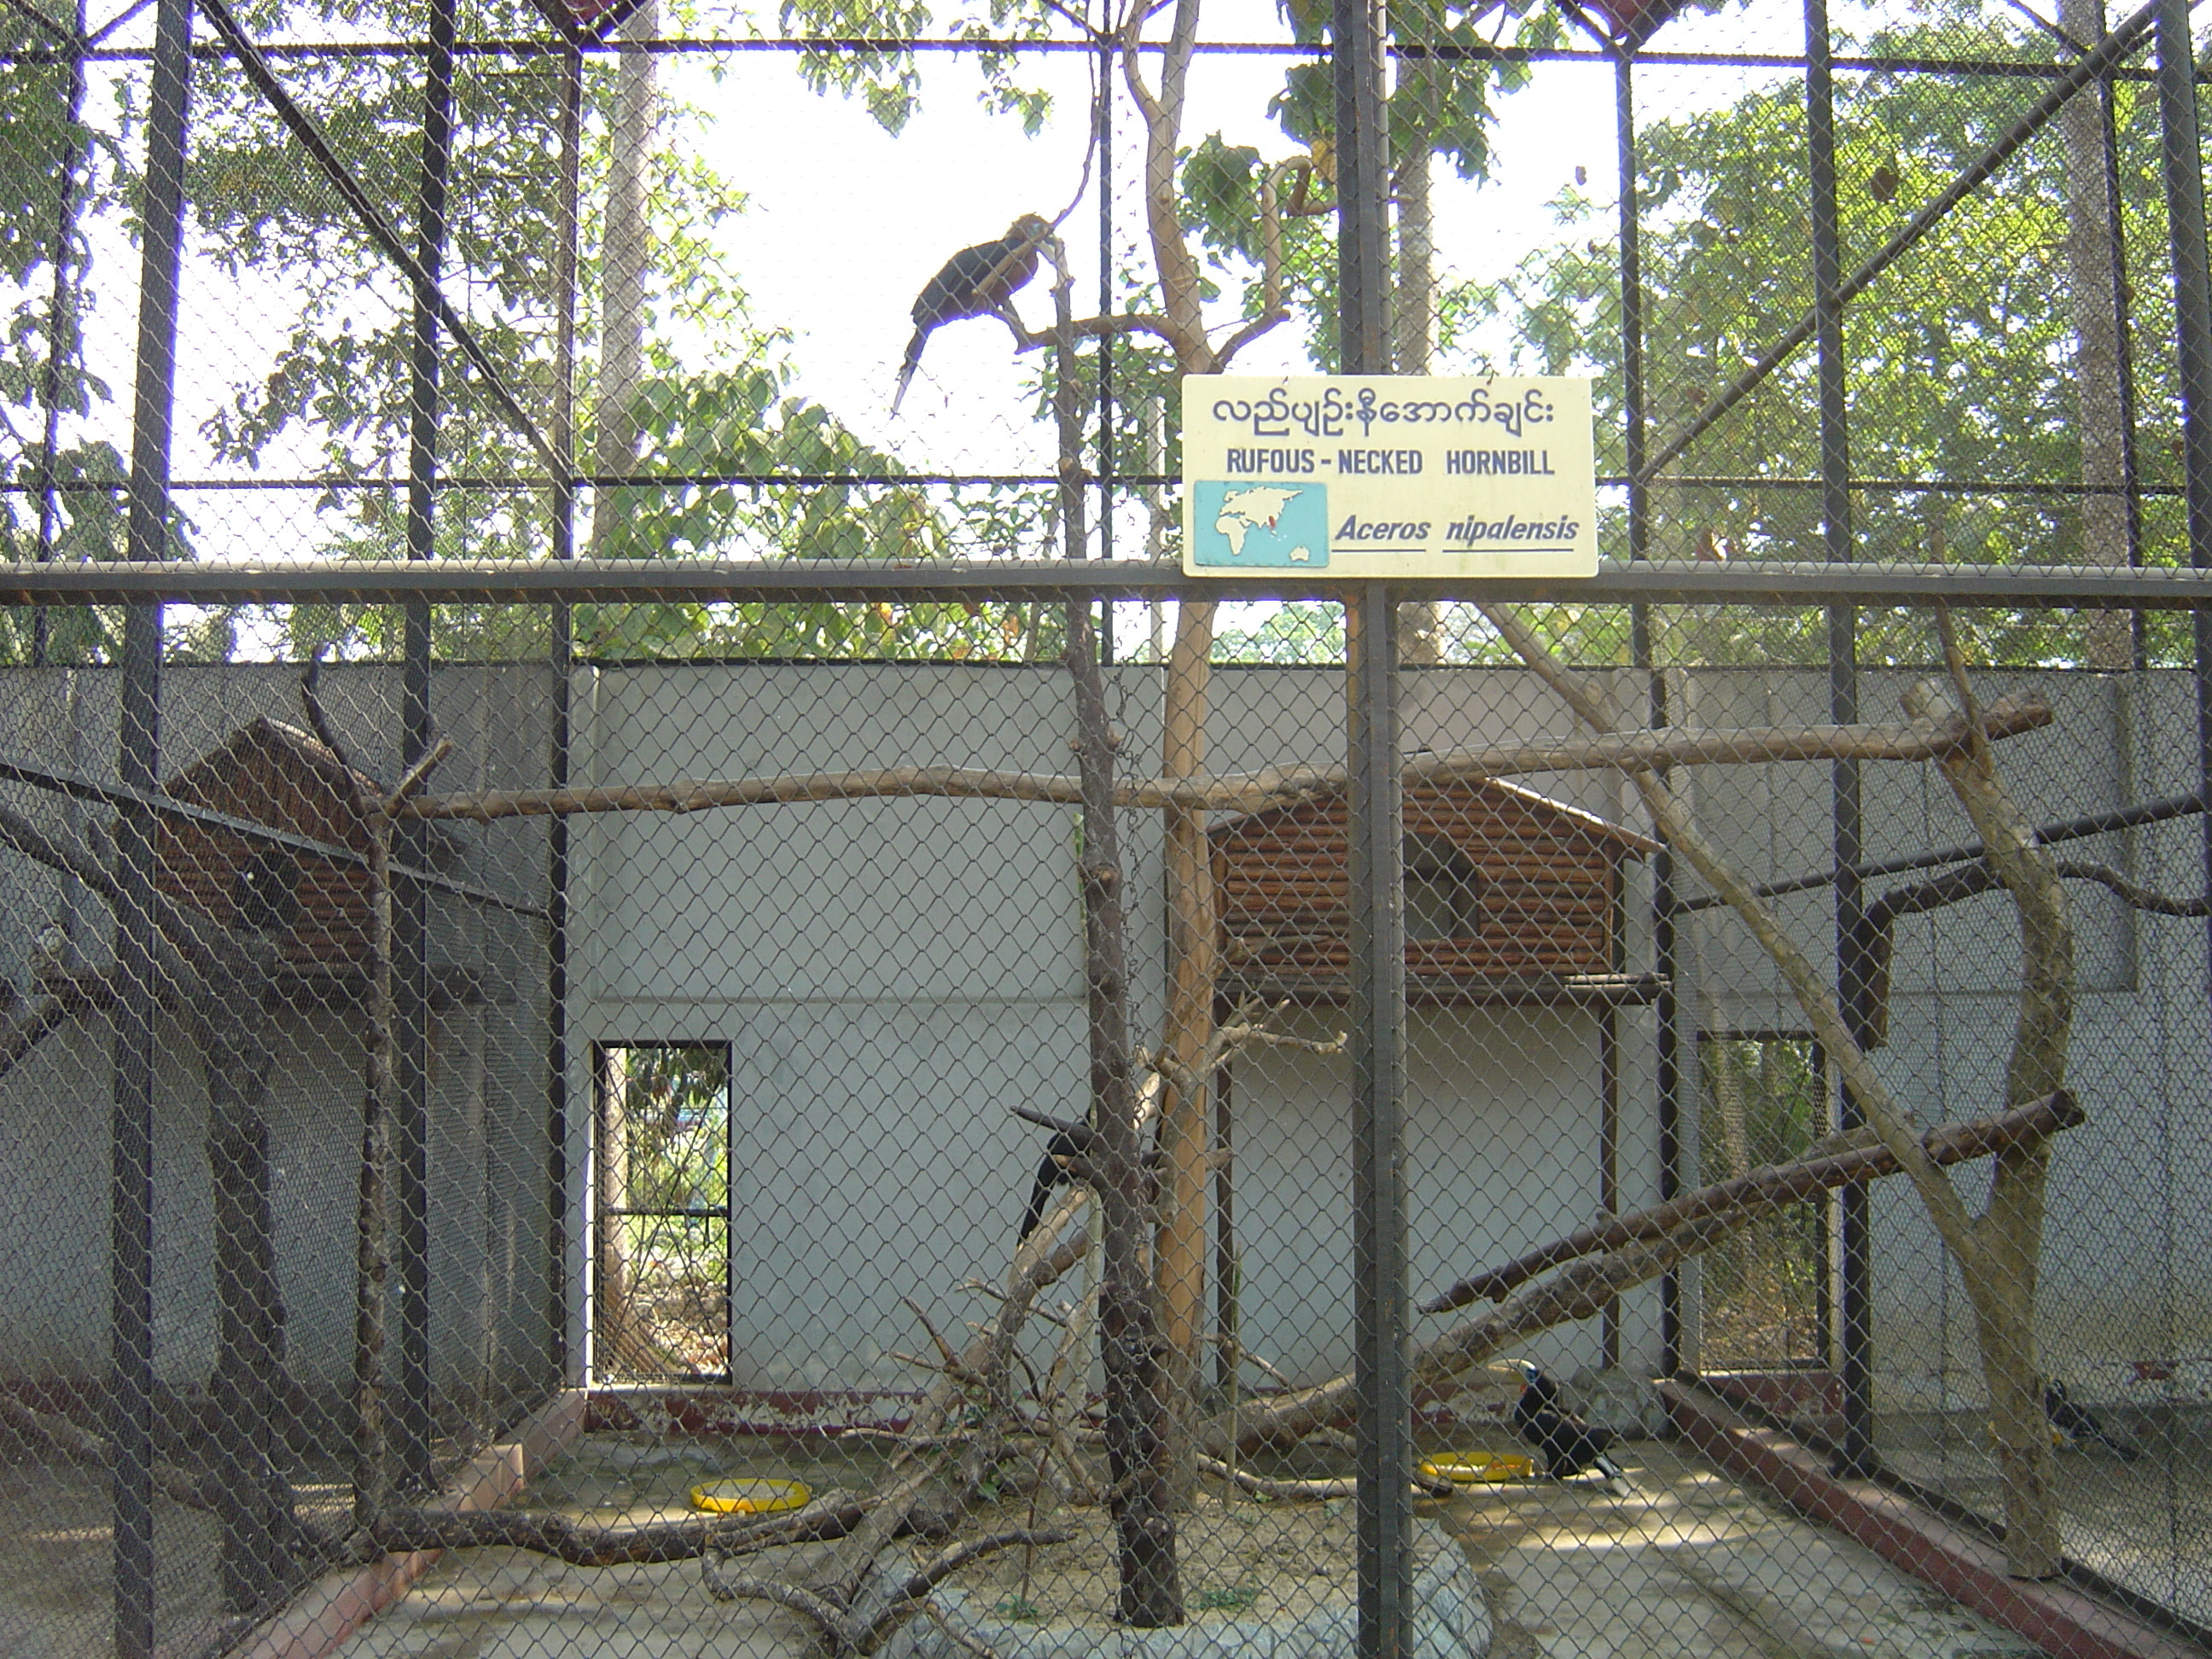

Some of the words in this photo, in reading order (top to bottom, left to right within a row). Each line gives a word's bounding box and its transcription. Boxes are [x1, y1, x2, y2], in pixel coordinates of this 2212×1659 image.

[1447, 450, 1555, 474] HORNBILL
[1335, 515, 1431, 540] Aceros
[1447, 515, 1579, 546] nipalensis
